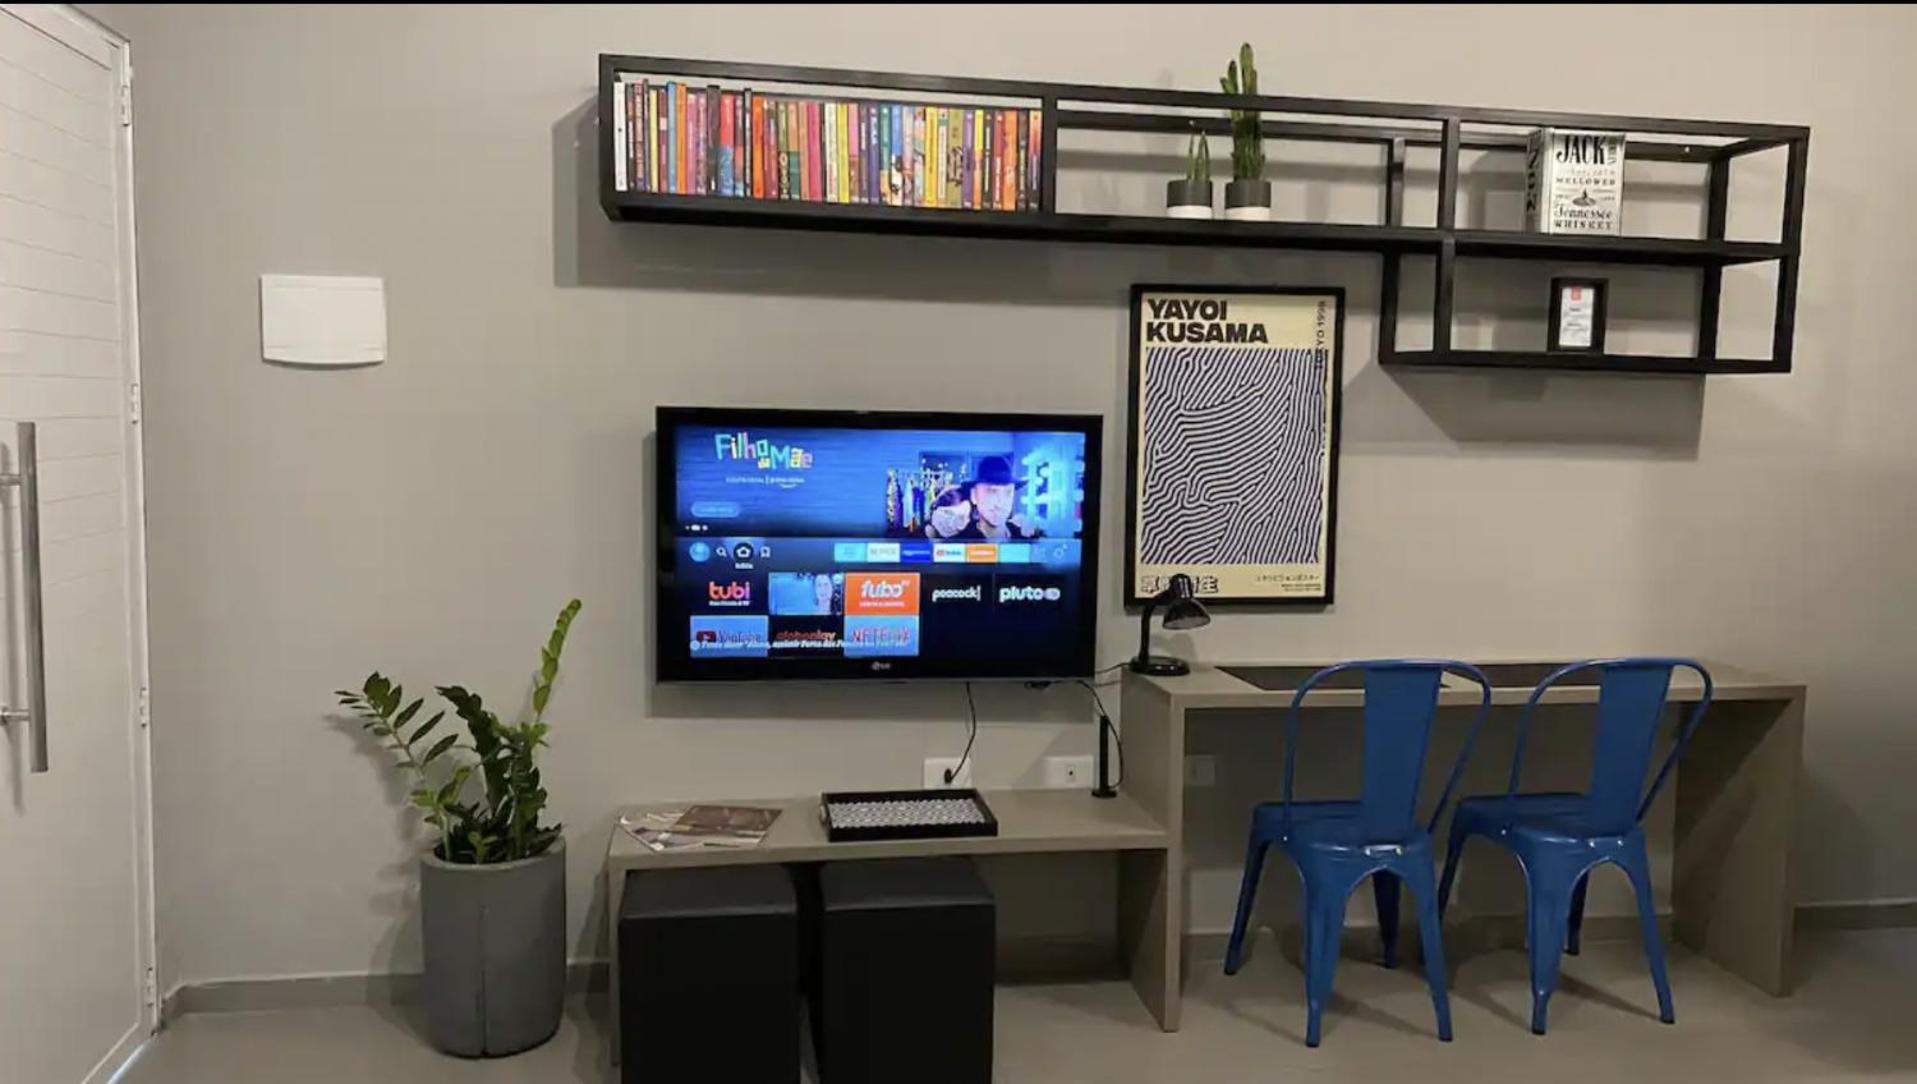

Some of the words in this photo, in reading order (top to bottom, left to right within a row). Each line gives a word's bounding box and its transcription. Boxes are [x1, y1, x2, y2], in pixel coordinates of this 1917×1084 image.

[1556, 135, 1607, 165] JACK
[1556, 177, 1616, 186] MELLOWED
[1554, 219, 1613, 230] WHISKEY
[1147, 299, 1228, 321] YAYOI
[1146, 322, 1268, 344] KUSAMA
[715, 432, 768, 460] Filho
[770, 445, 813, 469] Mãe
[708, 581, 750, 599] tubi
[860, 580, 903, 598] fubo
[932, 584, 977, 603] peacock
[999, 585, 1044, 603] pluto
